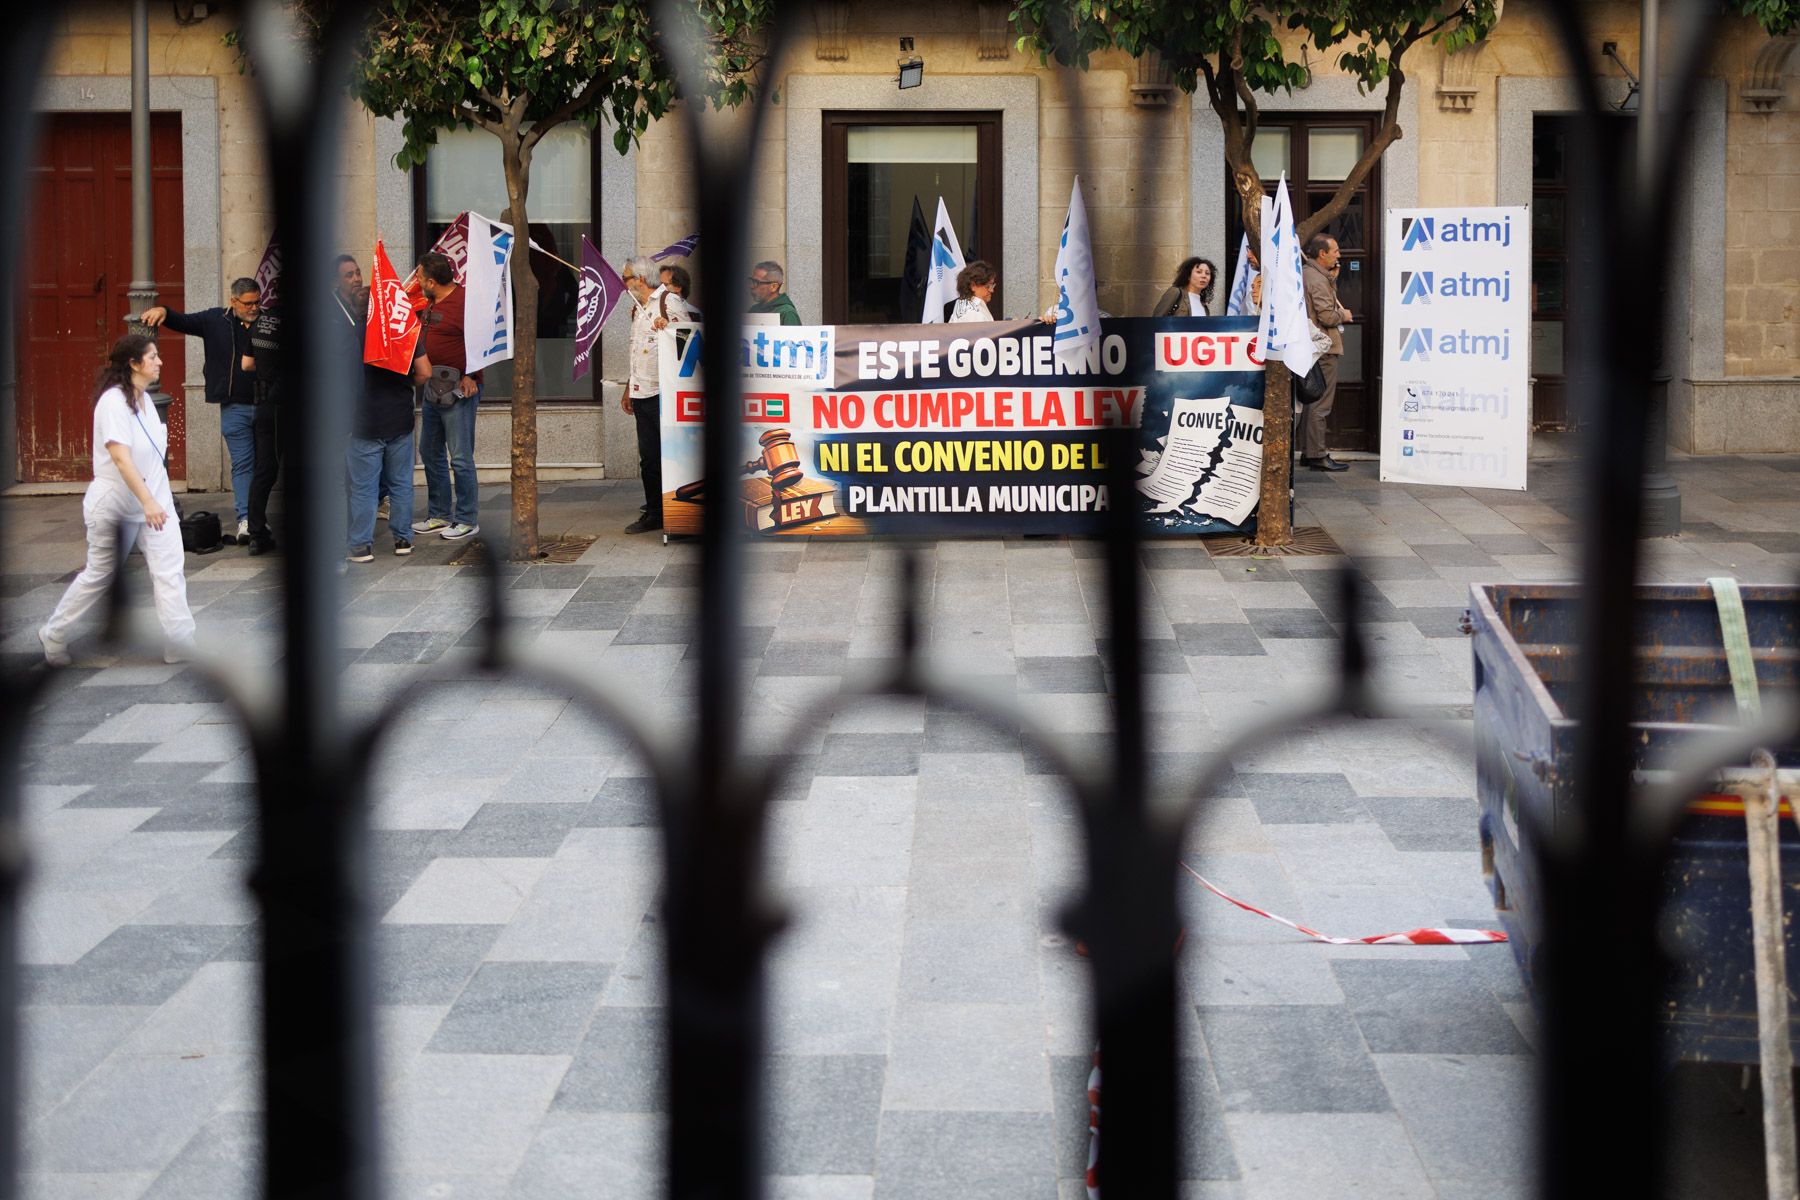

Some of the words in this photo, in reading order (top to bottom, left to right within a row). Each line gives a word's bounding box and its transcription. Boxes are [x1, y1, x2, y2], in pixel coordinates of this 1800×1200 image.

[80, 87, 96, 100] 14
[1440, 215, 1510, 247] atmj
[1439, 270, 1510, 303] atmj
[389, 289, 413, 334] UGT
[858, 339, 941, 380] ESTE
[1163, 335, 1240, 367] UGT
[1438, 328, 1510, 361] atmj
[812, 394, 866, 429] NO
[873, 390, 1015, 429] CUMPLE
[1022, 391, 1066, 428] LA
[1074, 389, 1138, 427] LEY
[819, 442, 850, 472] NI
[857, 442, 888, 473] EL
[894, 439, 1045, 472] CONVENIO
[1051, 443, 1085, 470] DE
[1091, 442, 1111, 470] L
[780, 499, 813, 523] LEY
[849, 485, 983, 513] PLANTILLA
[988, 484, 1111, 513] MUNICIPA
